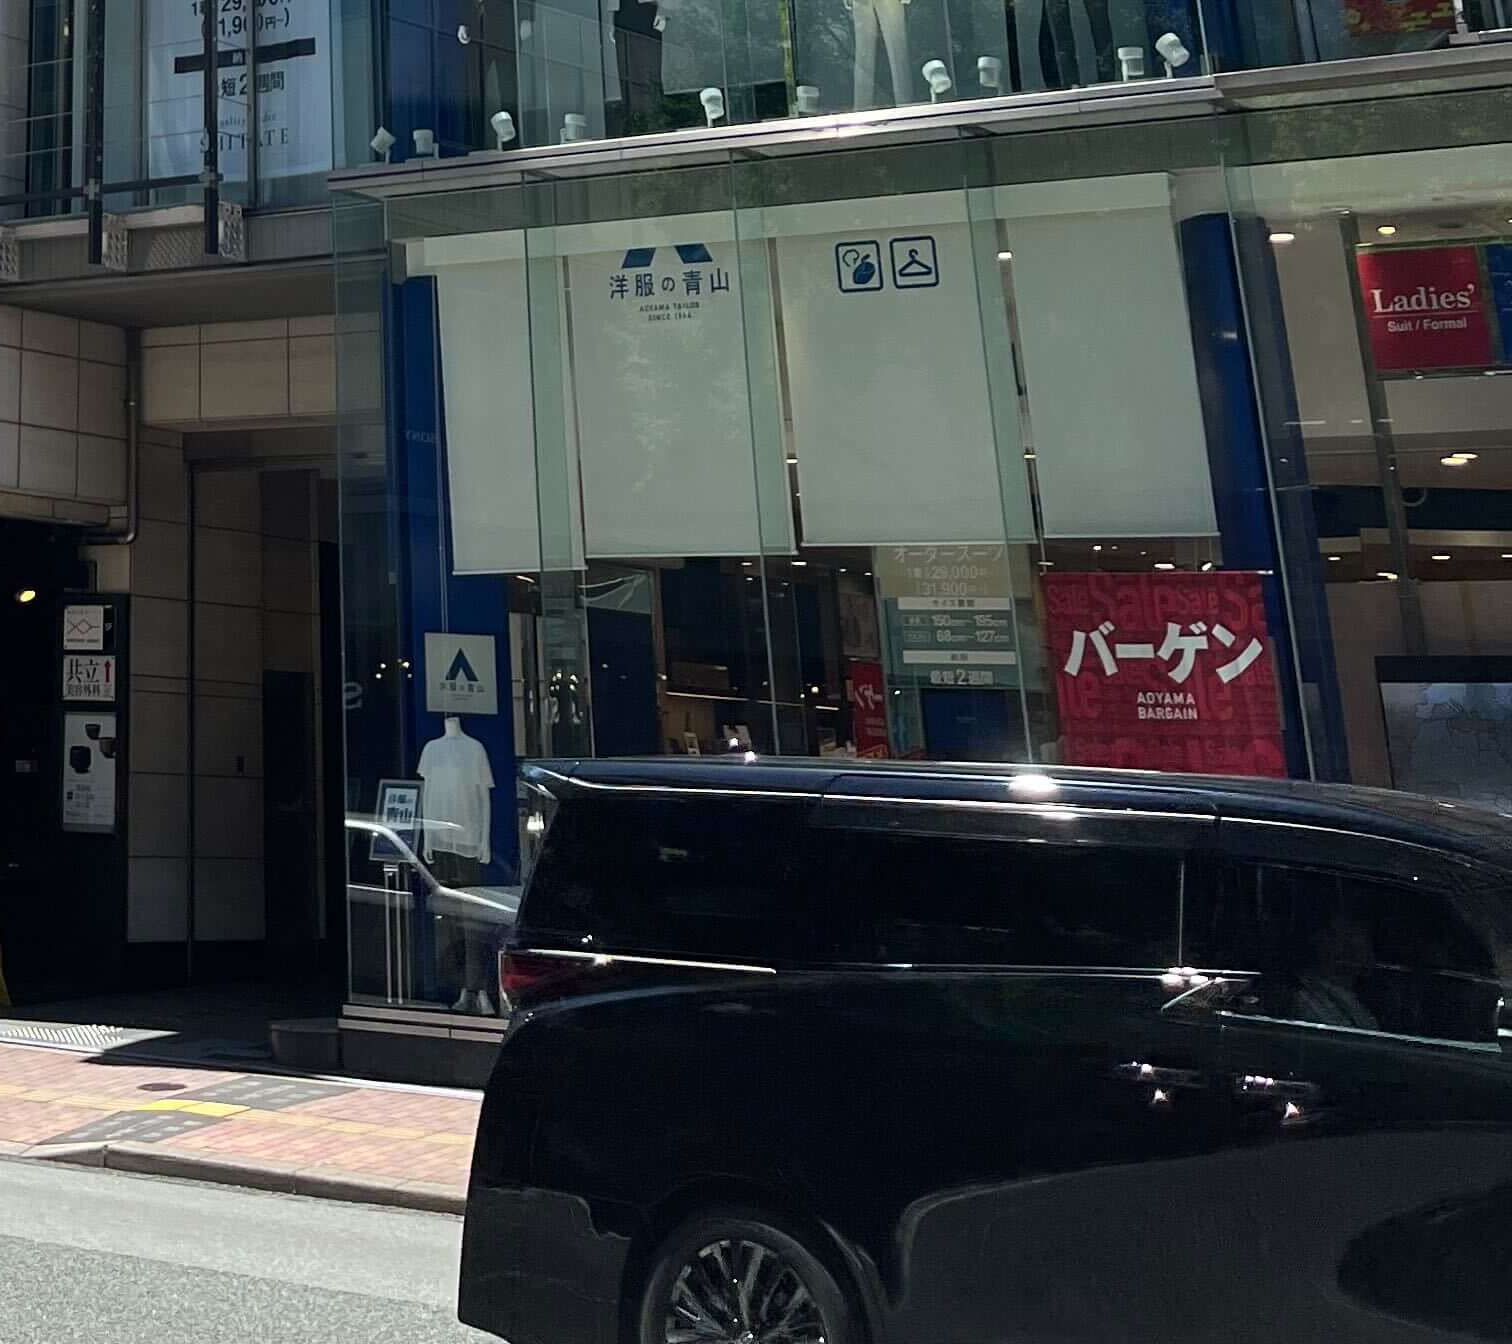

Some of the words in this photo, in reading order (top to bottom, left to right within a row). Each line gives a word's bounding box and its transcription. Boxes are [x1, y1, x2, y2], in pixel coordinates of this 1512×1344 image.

[609, 267, 730, 300] 洋服の青山
[1387, 319, 1412, 333] Suit
[1423, 316, 1468, 331] Formal
[1063, 620, 1264, 684] バーゲン
[67, 658, 100, 683] 共立
[1137, 692, 1196, 705] AOYAMA
[1137, 707, 1198, 720] BARGAIN
